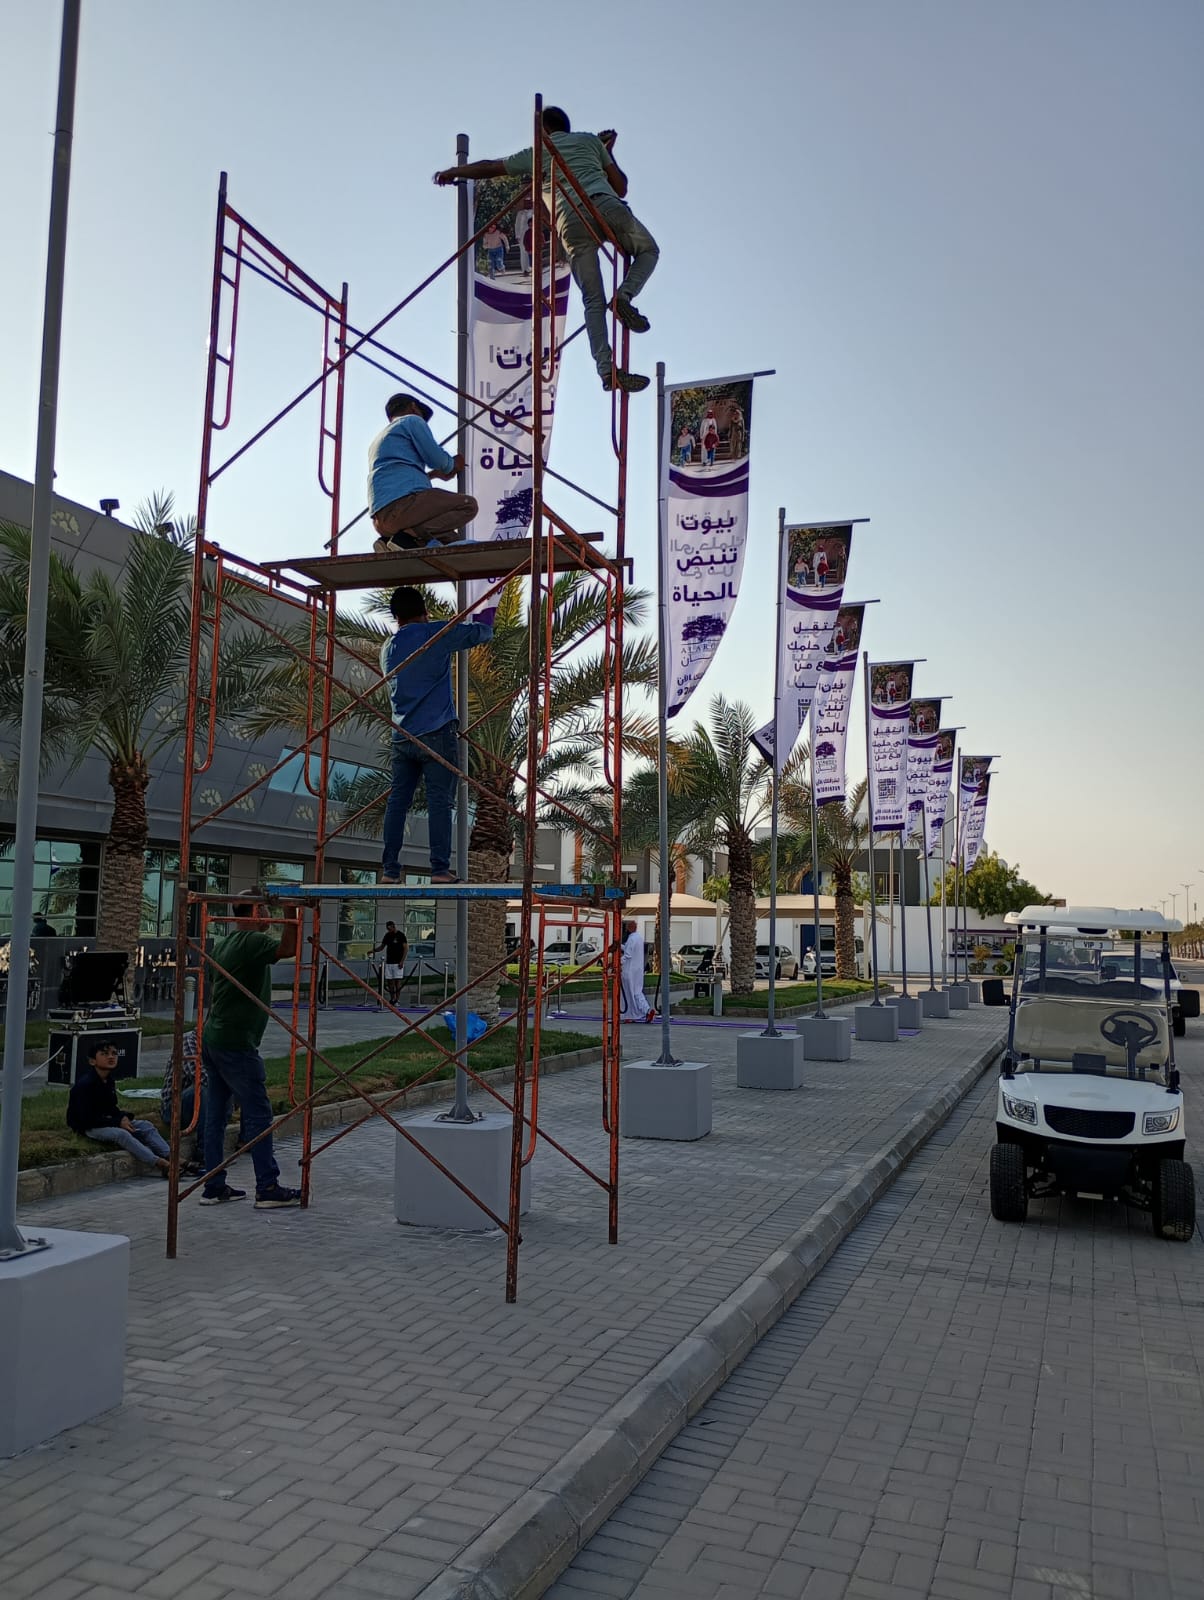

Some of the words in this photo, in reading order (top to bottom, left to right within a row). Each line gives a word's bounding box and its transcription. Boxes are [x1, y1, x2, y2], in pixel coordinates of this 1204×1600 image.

[681, 517, 734, 535] بيوت
[677, 548, 737, 572] تنبض
[1083, 941, 1095, 949] VIP
